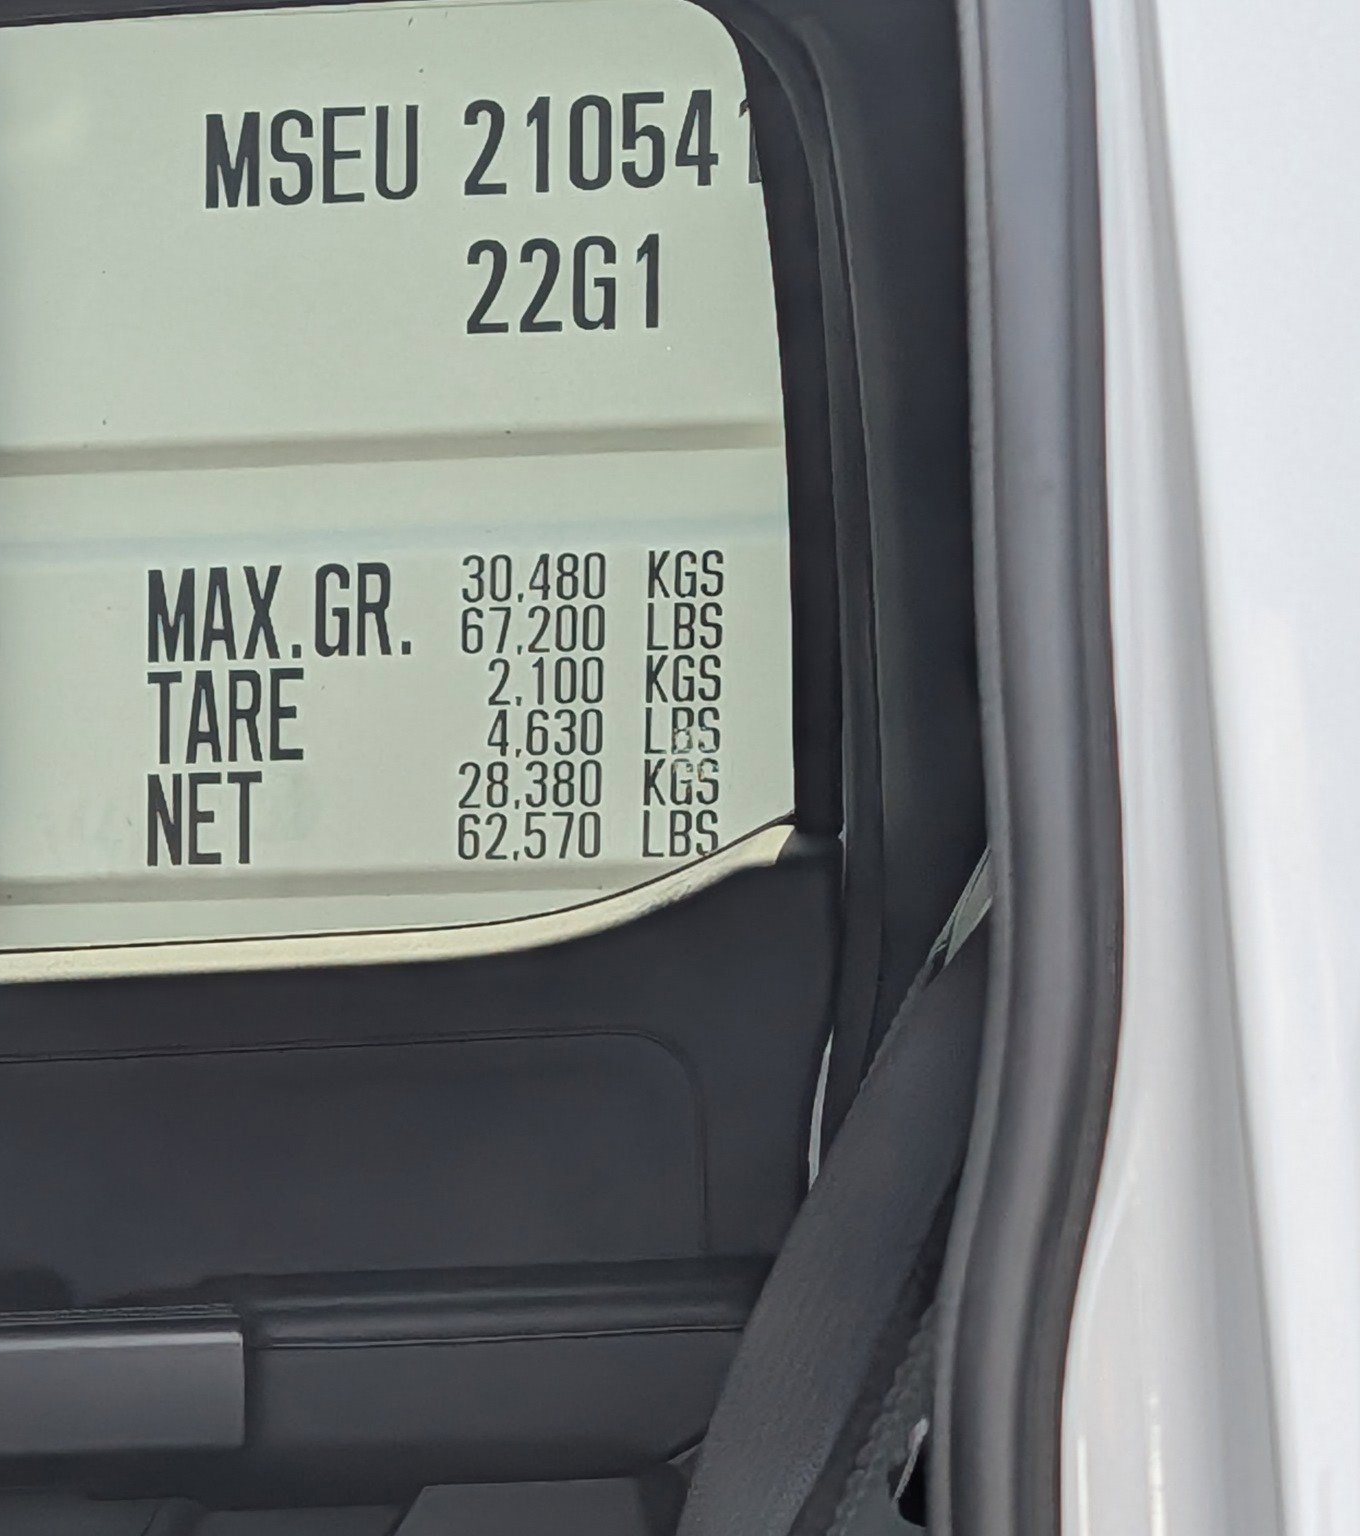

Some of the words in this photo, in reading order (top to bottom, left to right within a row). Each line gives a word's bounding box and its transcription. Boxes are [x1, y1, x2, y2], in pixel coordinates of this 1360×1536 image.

[206, 105, 418, 208] MSEU
[467, 234, 659, 334] 22G1
[148, 563, 411, 662] MAX.GR.
[462, 552, 605, 602] 30,480
[648, 550, 724, 598] KGS
[461, 604, 605, 655] 67,200
[646, 602, 723, 650] LBS
[148, 668, 304, 764] TARE
[488, 657, 604, 706] 2,100
[645, 655, 721, 703] KGS
[487, 709, 603, 758] 4,630
[644, 707, 720, 755] LBS
[148, 771, 263, 866] NET
[458, 760, 602, 809] 28,380
[643, 758, 719, 806] KGS
[458, 812, 601, 861] 62,570
[642, 810, 718, 857] LBS
